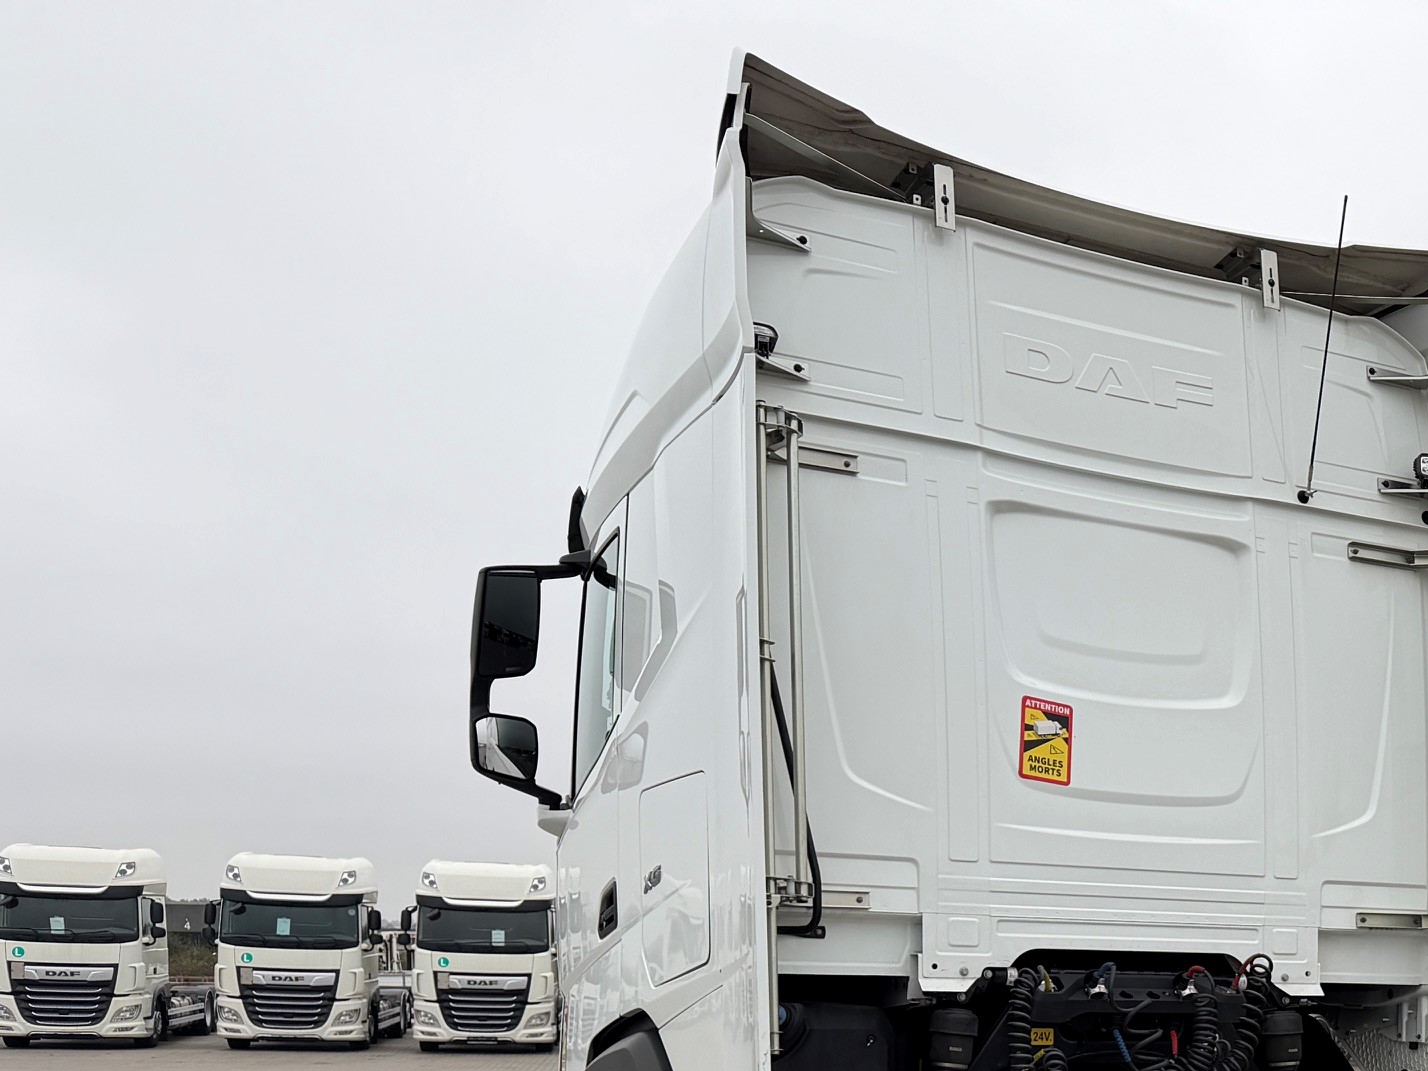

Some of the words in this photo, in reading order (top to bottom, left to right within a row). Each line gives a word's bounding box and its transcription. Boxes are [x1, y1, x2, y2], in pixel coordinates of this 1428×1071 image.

[1003, 332, 1213, 409] DAF
[1025, 699, 1070, 715] ATTENTION
[1027, 754, 1064, 769] ANGLES
[1029, 764, 1062, 777] MORTS
[14, 948, 22, 957] L
[243, 954, 251, 963] L
[440, 957, 447, 966] L
[1032, 1031, 1052, 1042] 24V.
